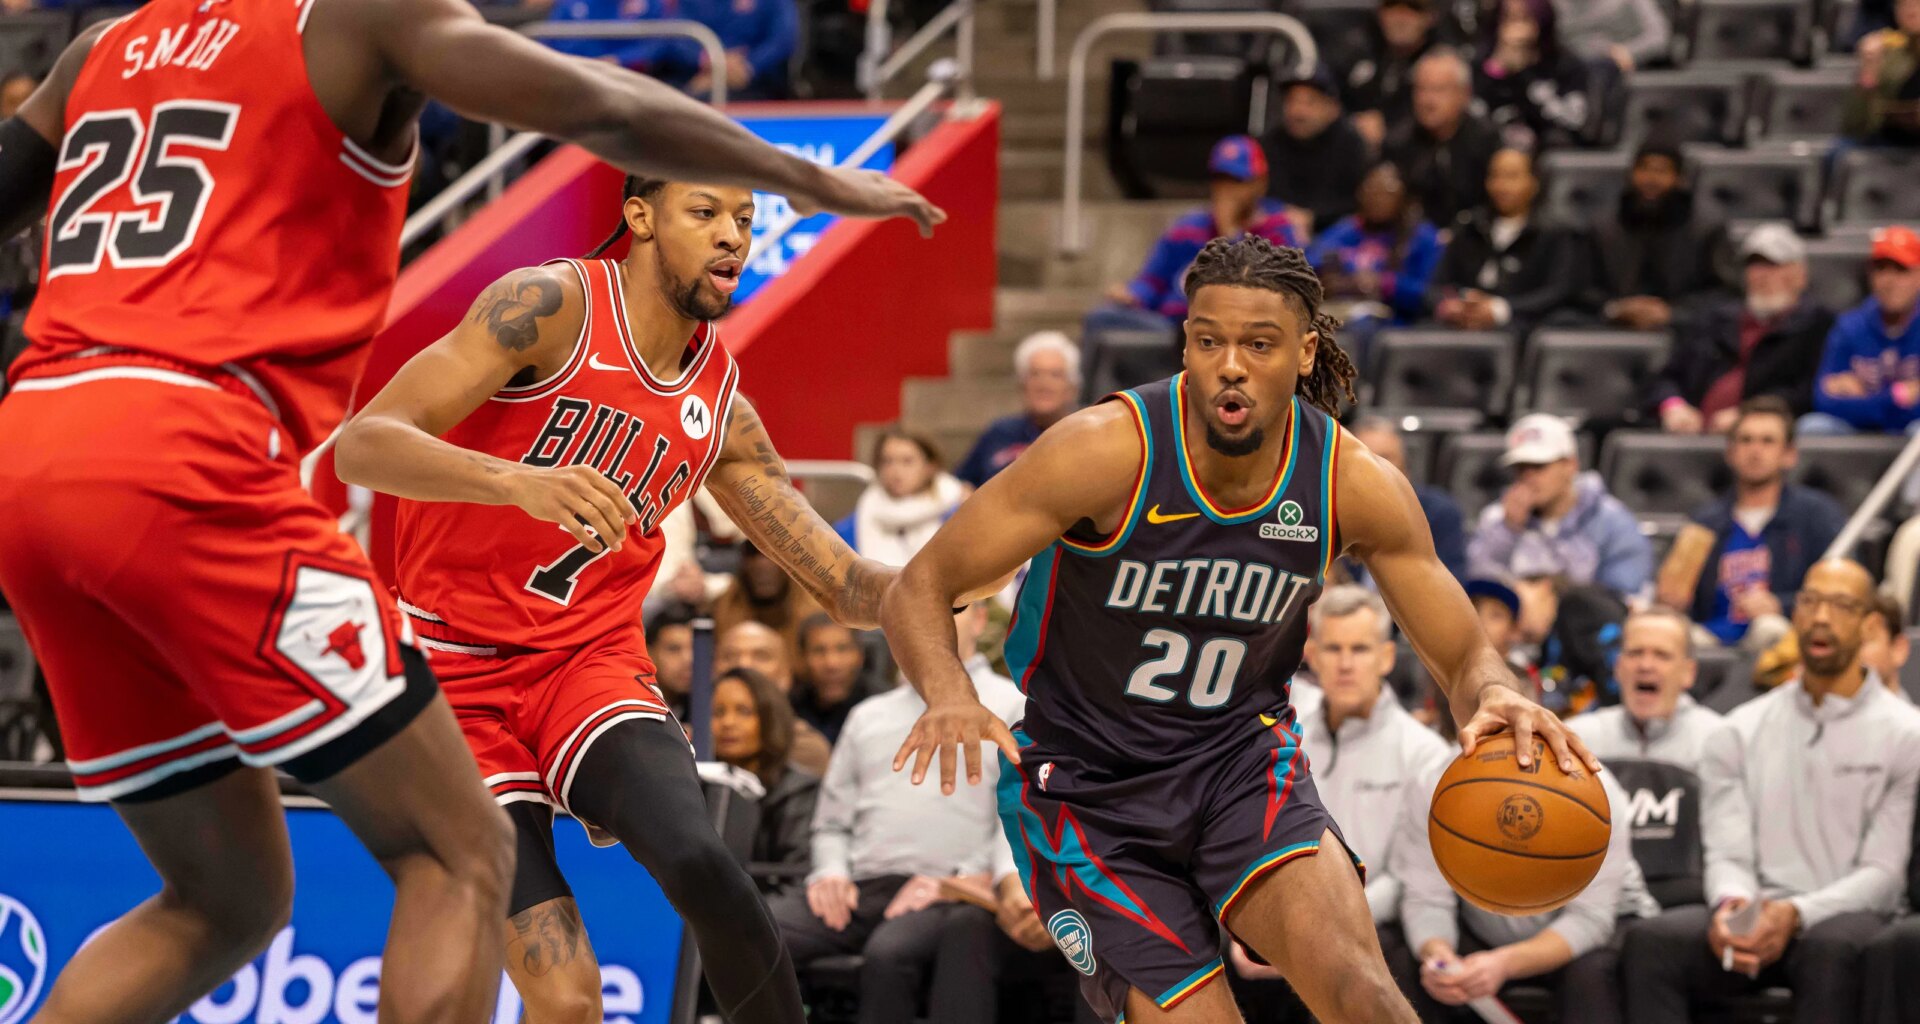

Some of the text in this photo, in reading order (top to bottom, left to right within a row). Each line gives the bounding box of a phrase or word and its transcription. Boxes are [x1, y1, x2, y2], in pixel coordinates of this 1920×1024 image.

[47, 98, 241, 282] 25
[520, 396, 691, 537] BULLS
[731, 474, 771, 518] Nobody
[756, 507, 793, 546] praying
[1261, 525, 1316, 539] StockX
[524, 512, 613, 607] 7
[1105, 558, 1310, 624] DETROIT
[1124, 627, 1248, 709] 20
